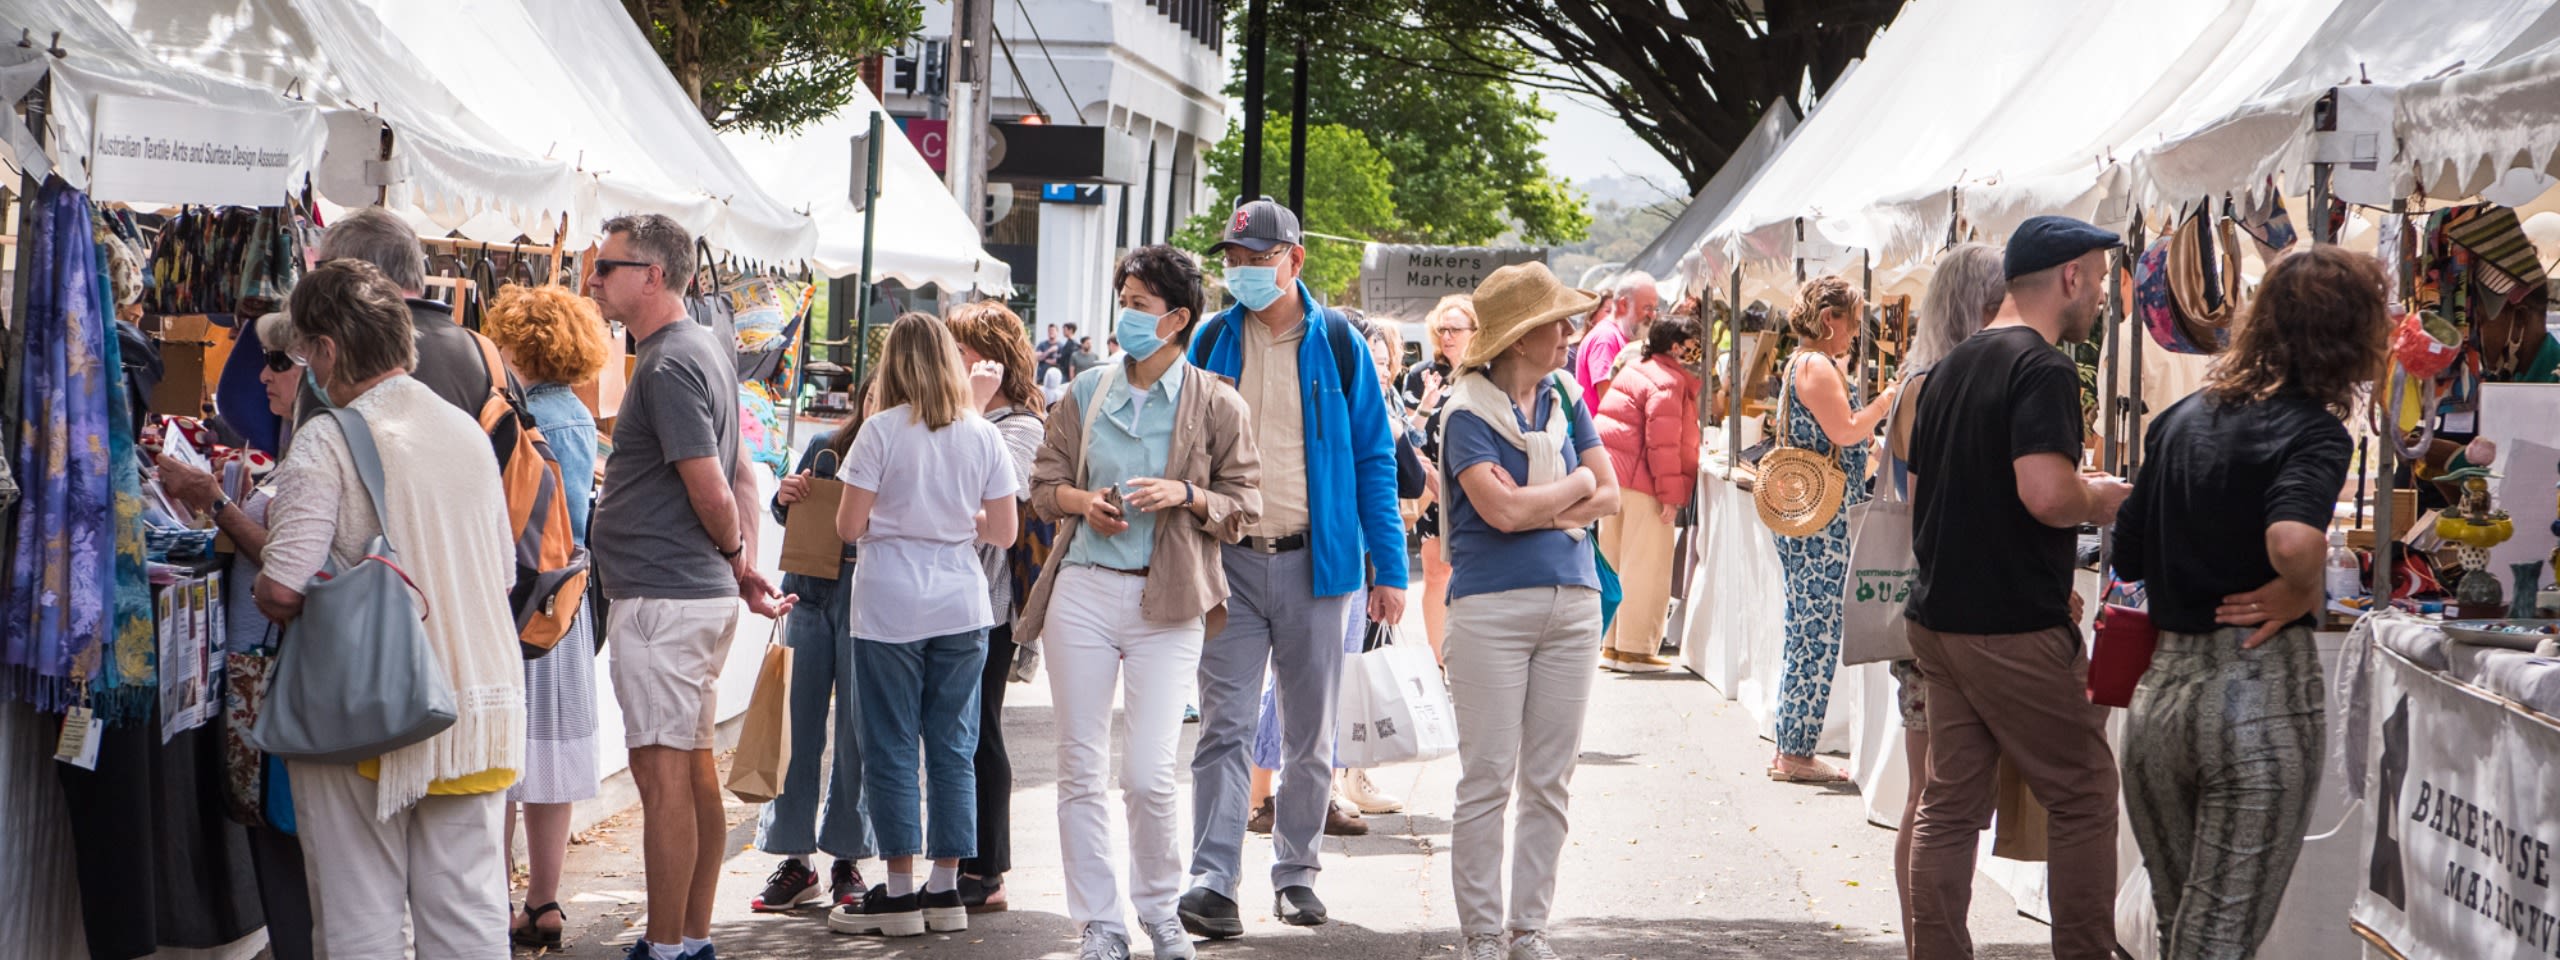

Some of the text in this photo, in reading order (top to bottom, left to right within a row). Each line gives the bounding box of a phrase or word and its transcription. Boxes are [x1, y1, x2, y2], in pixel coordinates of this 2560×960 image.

[98, 133, 289, 171] Australian Textile Arts and Surface Design Association
[922, 132, 942, 158] C
[1408, 253, 1481, 270] Makers
[1407, 271, 1481, 289] Market
